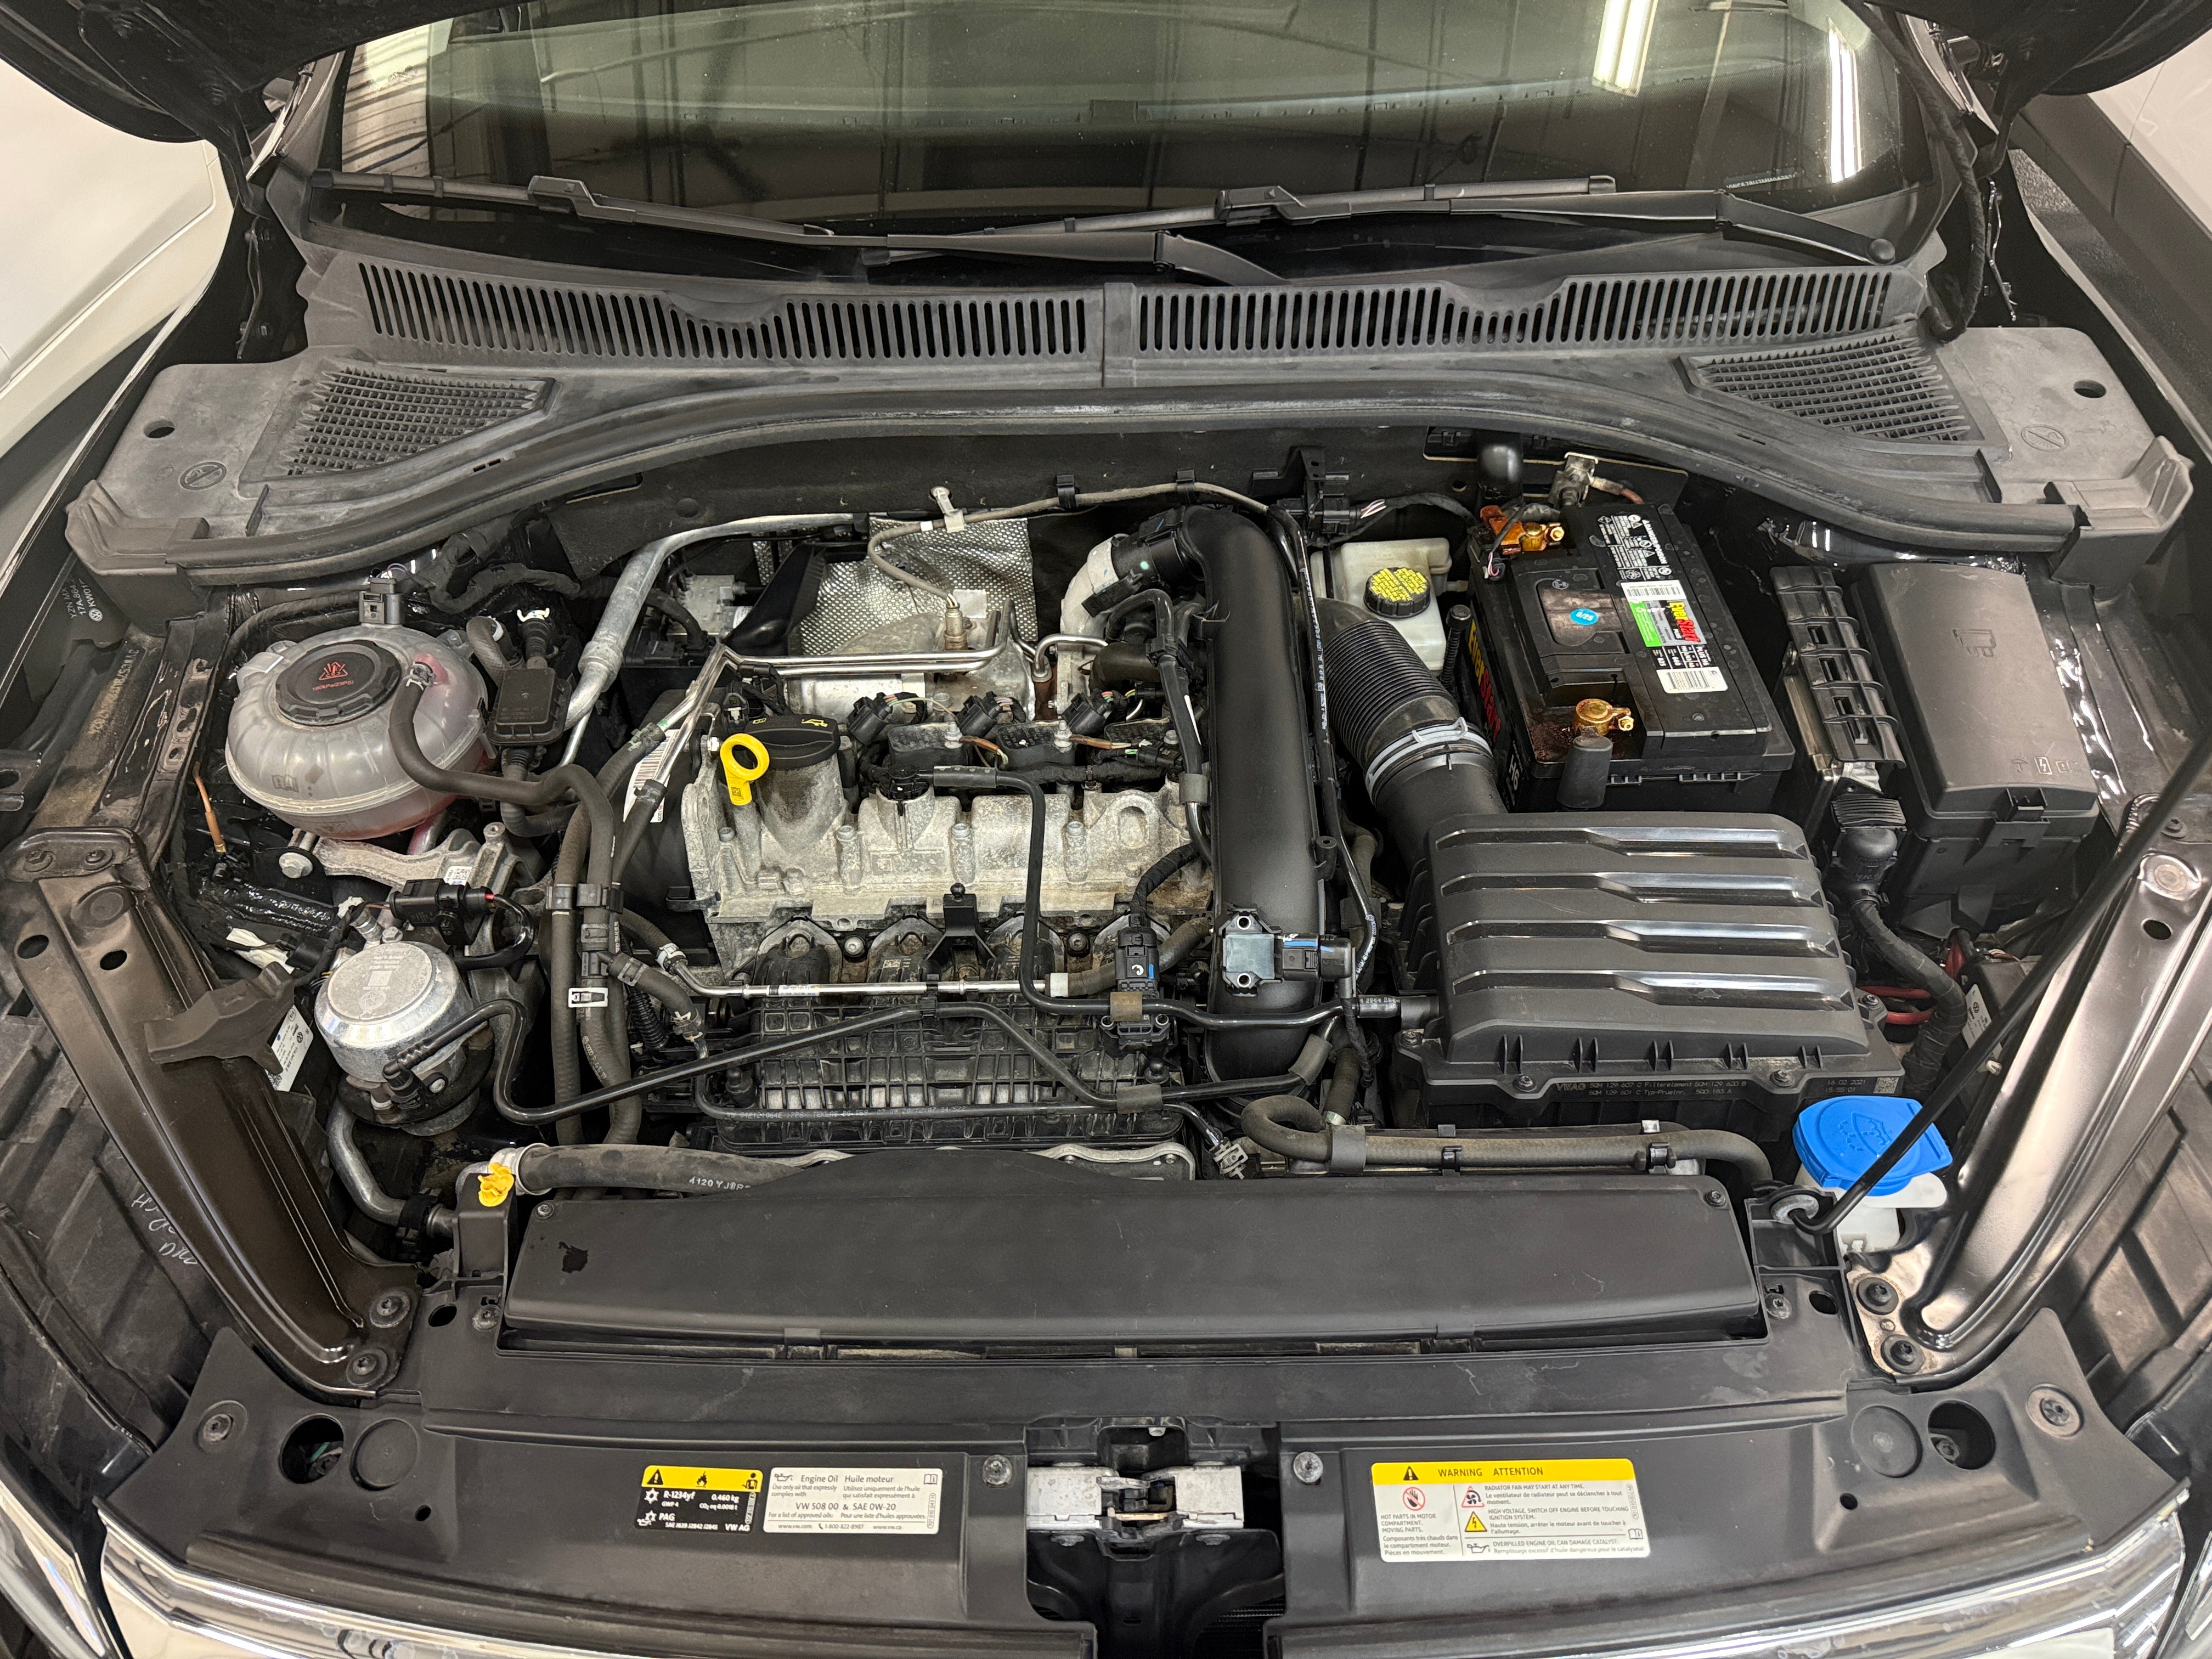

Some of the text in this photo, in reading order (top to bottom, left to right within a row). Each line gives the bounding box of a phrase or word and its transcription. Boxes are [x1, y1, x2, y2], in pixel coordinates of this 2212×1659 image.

[1669, 602, 1701, 642] EverStart
[1696, 646, 1707, 658] PLUS
[1509, 754, 1520, 791] H6
[1438, 1467, 1544, 1477] WARNING ATTENTION
[801, 1475, 826, 1485] Engine
[663, 1490, 696, 1502] R-1234yf
[730, 1495, 740, 1503] kg
[658, 1513, 676, 1521] PAG
